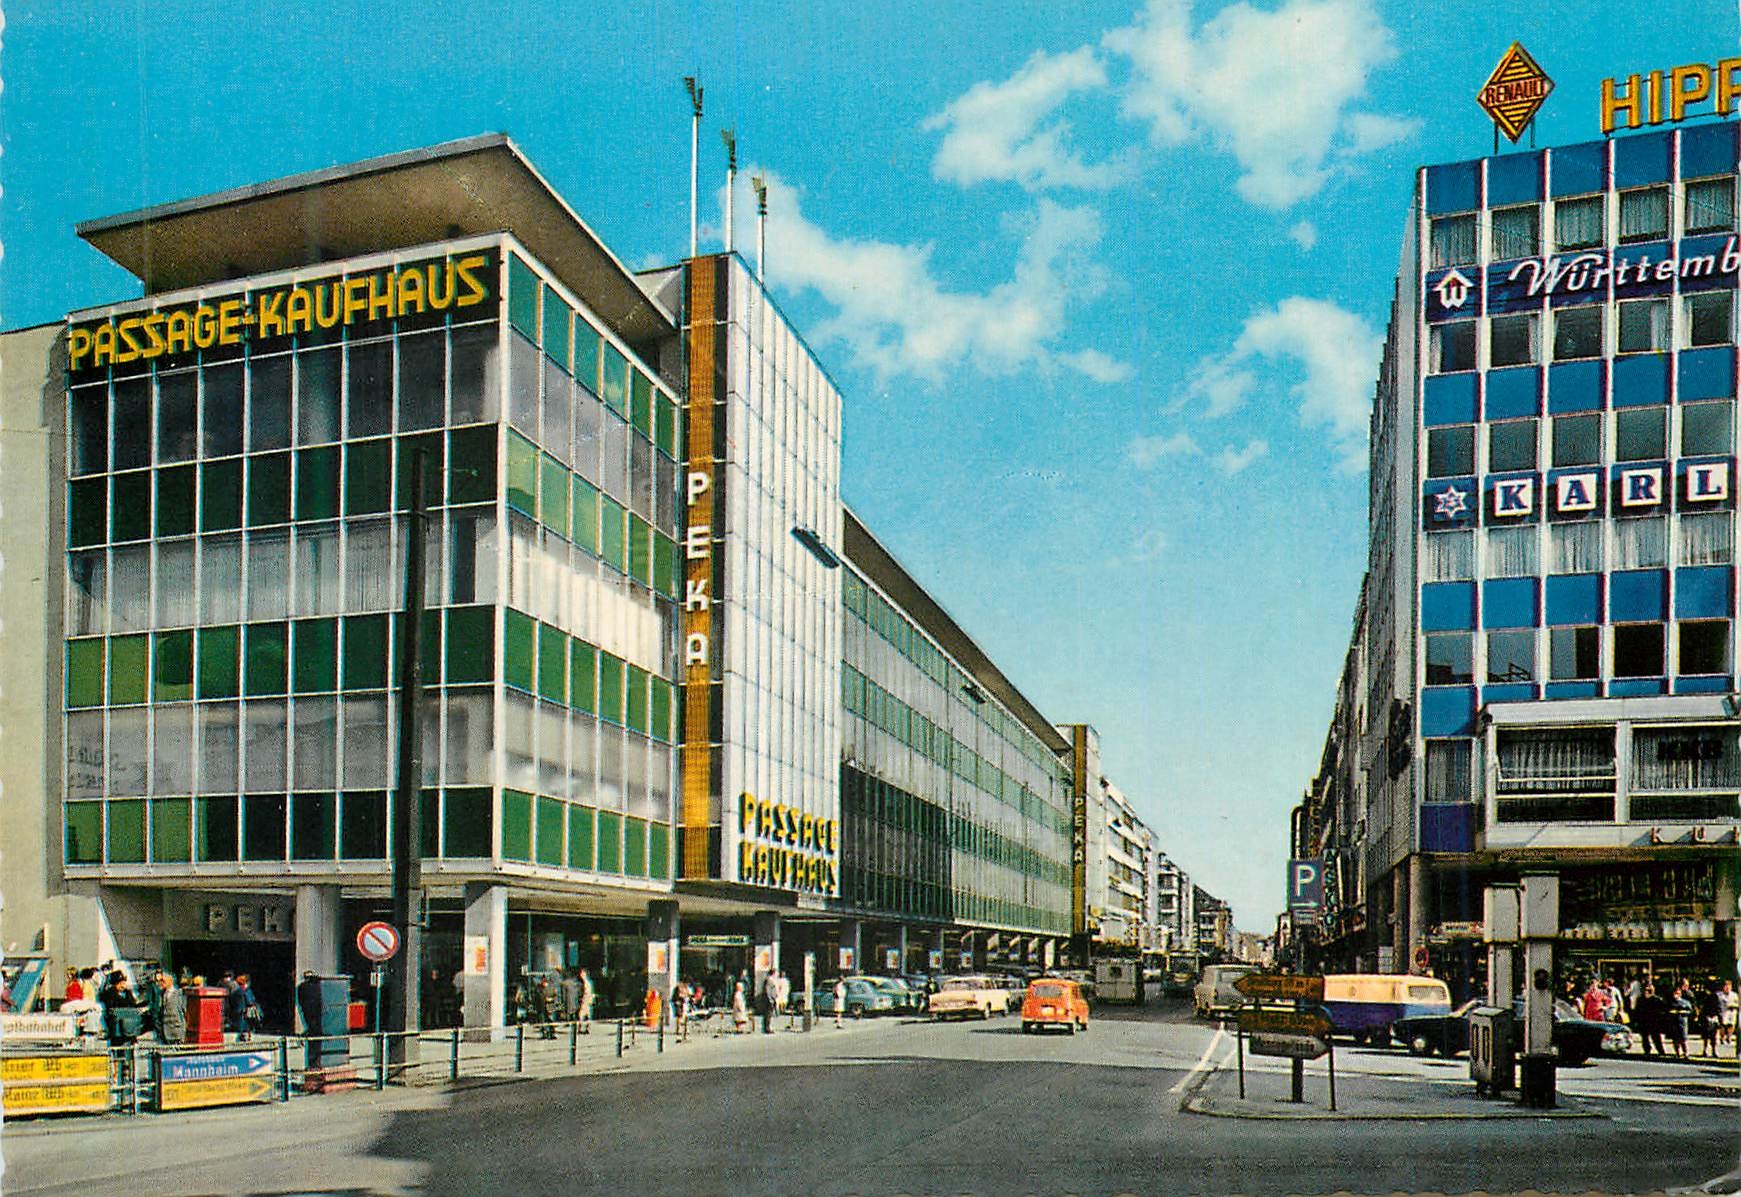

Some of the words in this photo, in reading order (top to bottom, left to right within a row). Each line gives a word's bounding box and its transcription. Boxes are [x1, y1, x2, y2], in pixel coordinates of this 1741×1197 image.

[1486, 78, 1546, 104] RENAULT
[1508, 236, 1741, 297] Württemb
[69, 256, 488, 371] PASSAGE-KAUFHAUS
[1500, 470, 1722, 511] KARL
[686, 471, 710, 666] PEKA
[738, 792, 838, 856] PASSAGE
[1075, 797, 1084, 863] PEKA
[738, 841, 838, 895] KAUFHAUS
[1295, 865, 1316, 897] P
[172, 1063, 239, 1079] Mannheim
